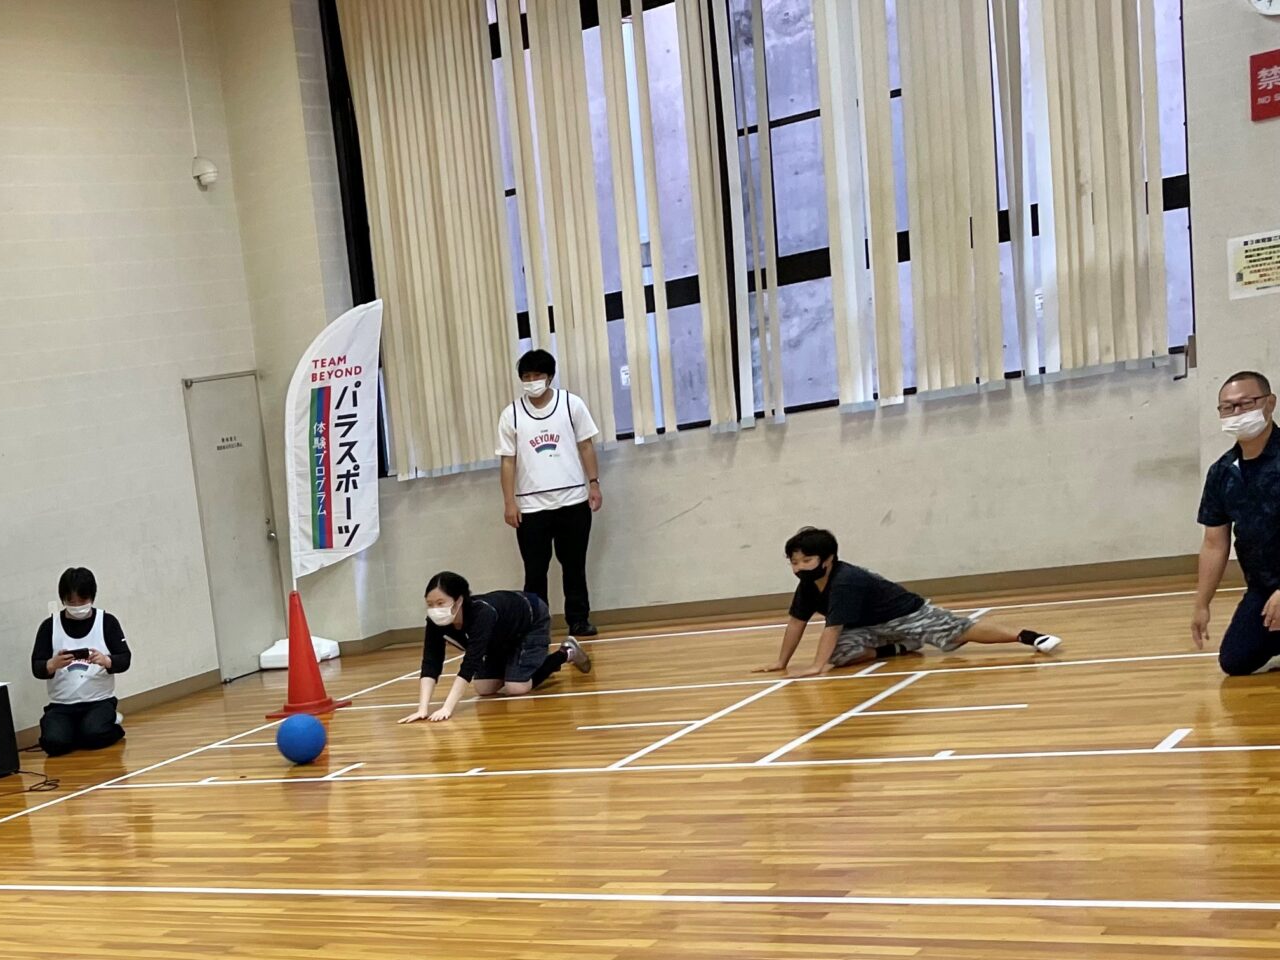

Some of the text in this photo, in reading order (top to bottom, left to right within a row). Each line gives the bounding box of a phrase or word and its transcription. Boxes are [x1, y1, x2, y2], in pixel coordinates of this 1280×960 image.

[312, 355, 347, 369] TEAM
[311, 365, 362, 382] BEYOND
[529, 433, 560, 447] BEYOND
[312, 421, 327, 515] 体験プログラム
[334, 380, 362, 547] パラスポーツ
